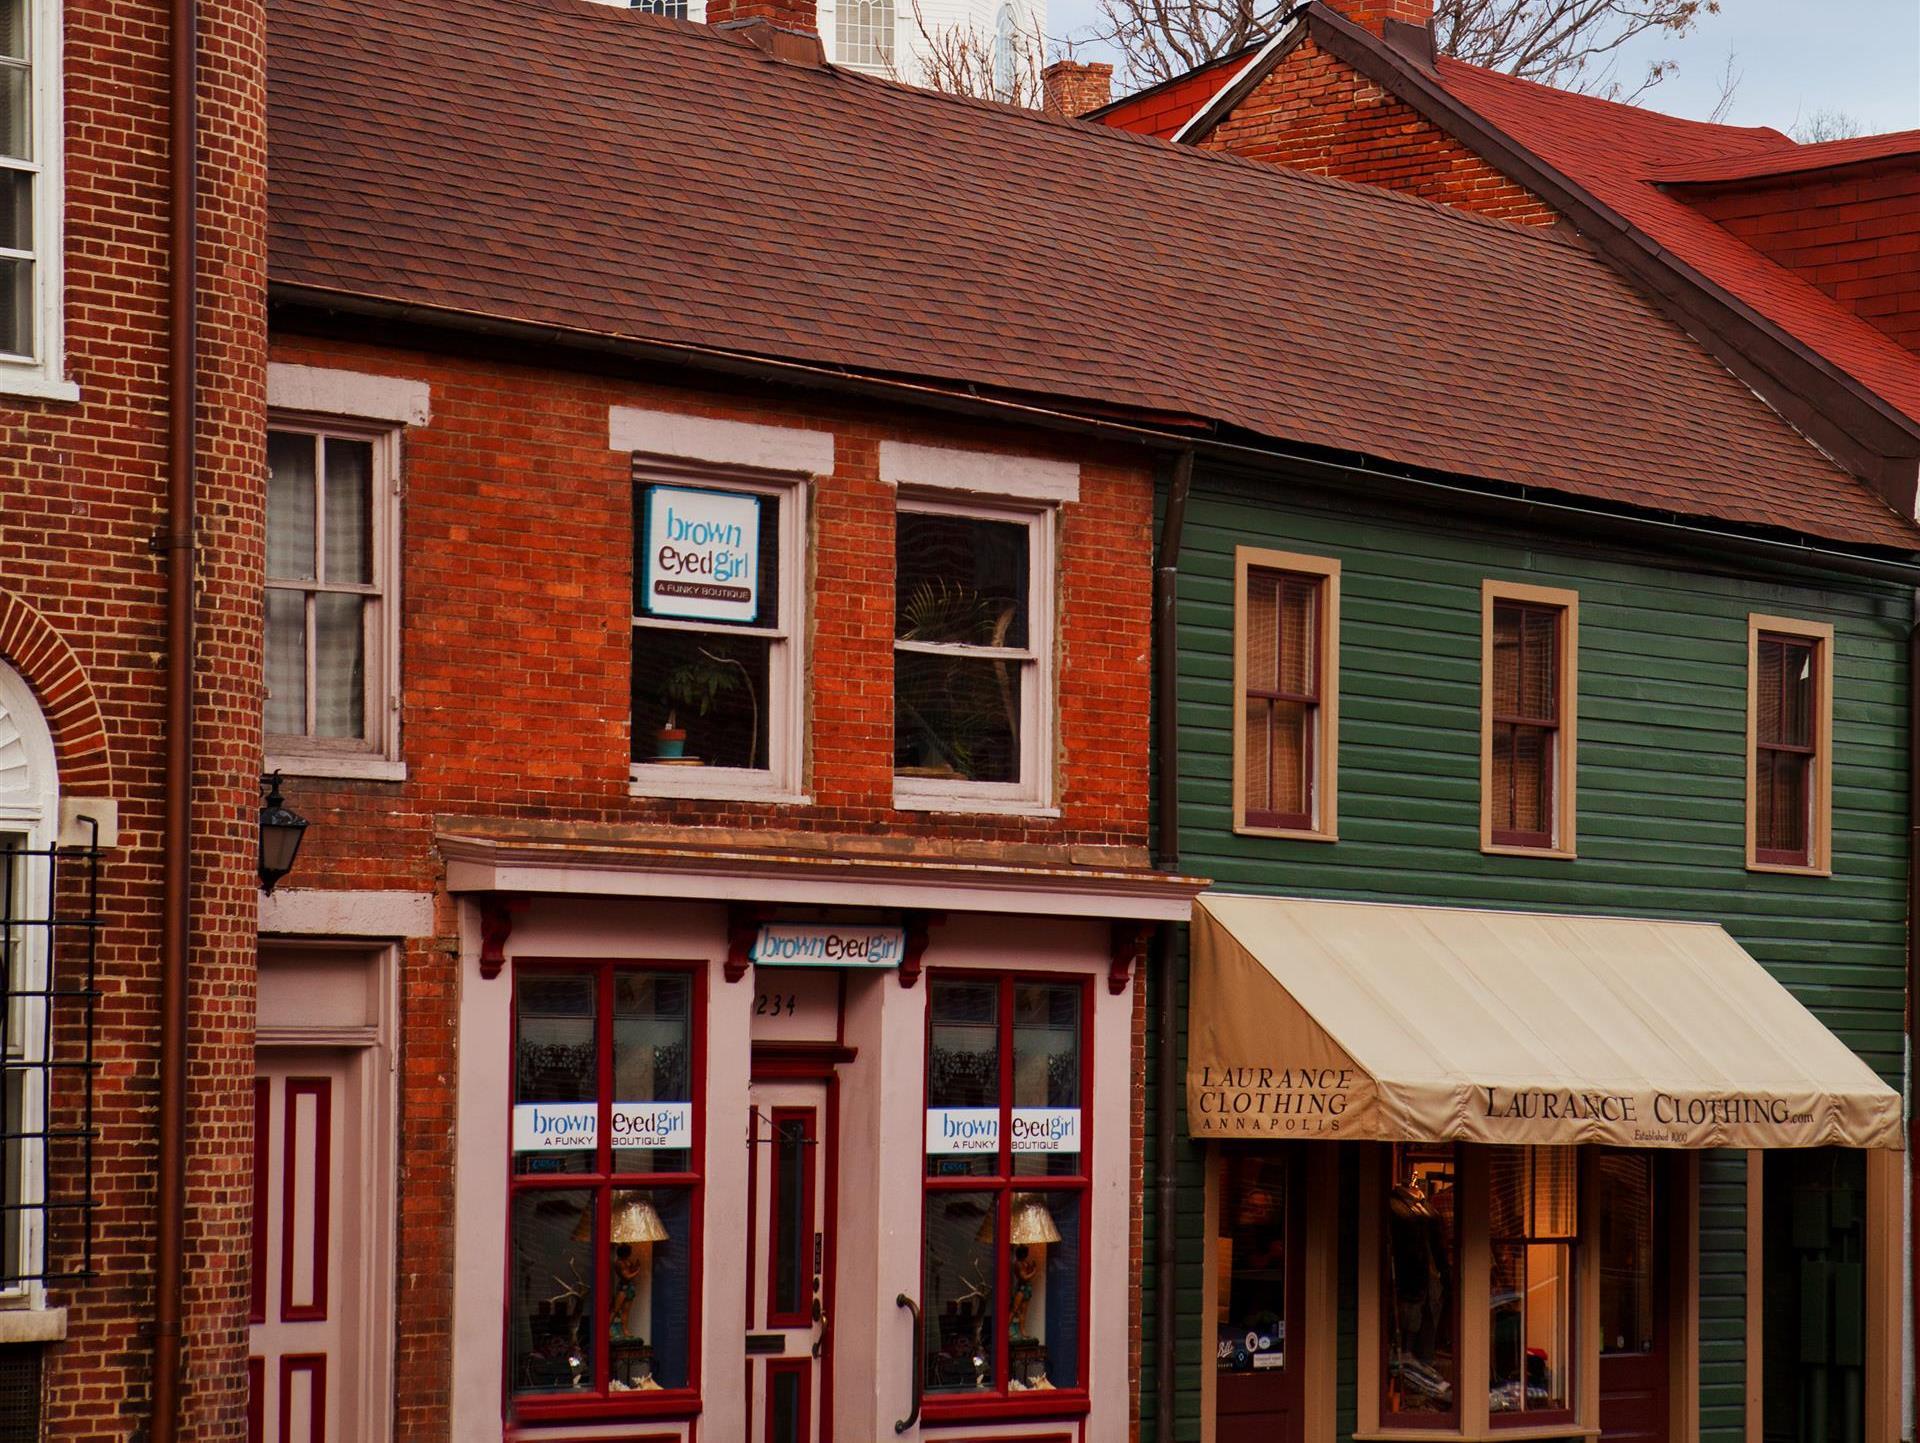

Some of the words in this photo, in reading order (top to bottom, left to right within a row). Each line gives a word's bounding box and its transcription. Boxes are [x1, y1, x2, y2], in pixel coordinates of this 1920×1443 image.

[666, 507, 742, 548] brown
[659, 545, 748, 582] eyedgirl
[657, 583, 666, 592] A
[667, 584, 699, 595] FUNKY
[701, 587, 749, 599] BOUTIQUE
[756, 994, 796, 1017] 234
[1201, 1066, 1354, 1089] LAURANCE
[1200, 1091, 1349, 1115] CLOTHING
[1483, 1087, 1638, 1122] LAURANCE
[533, 1108, 596, 1135] brown
[612, 1110, 684, 1136] eyedgirl
[943, 1112, 998, 1138] brown
[1012, 1115, 1074, 1140] eyedgirl
[1202, 1118, 1341, 1132] ANNAPOLIS
[544, 1137, 552, 1146] A
[555, 1136, 594, 1145] FUNKY
[612, 1136, 666, 1146] BOUTIQUE
[952, 1141, 960, 1149] A
[963, 1140, 997, 1149] FUNKY
[1011, 1141, 1060, 1150] BOUTIQUE
